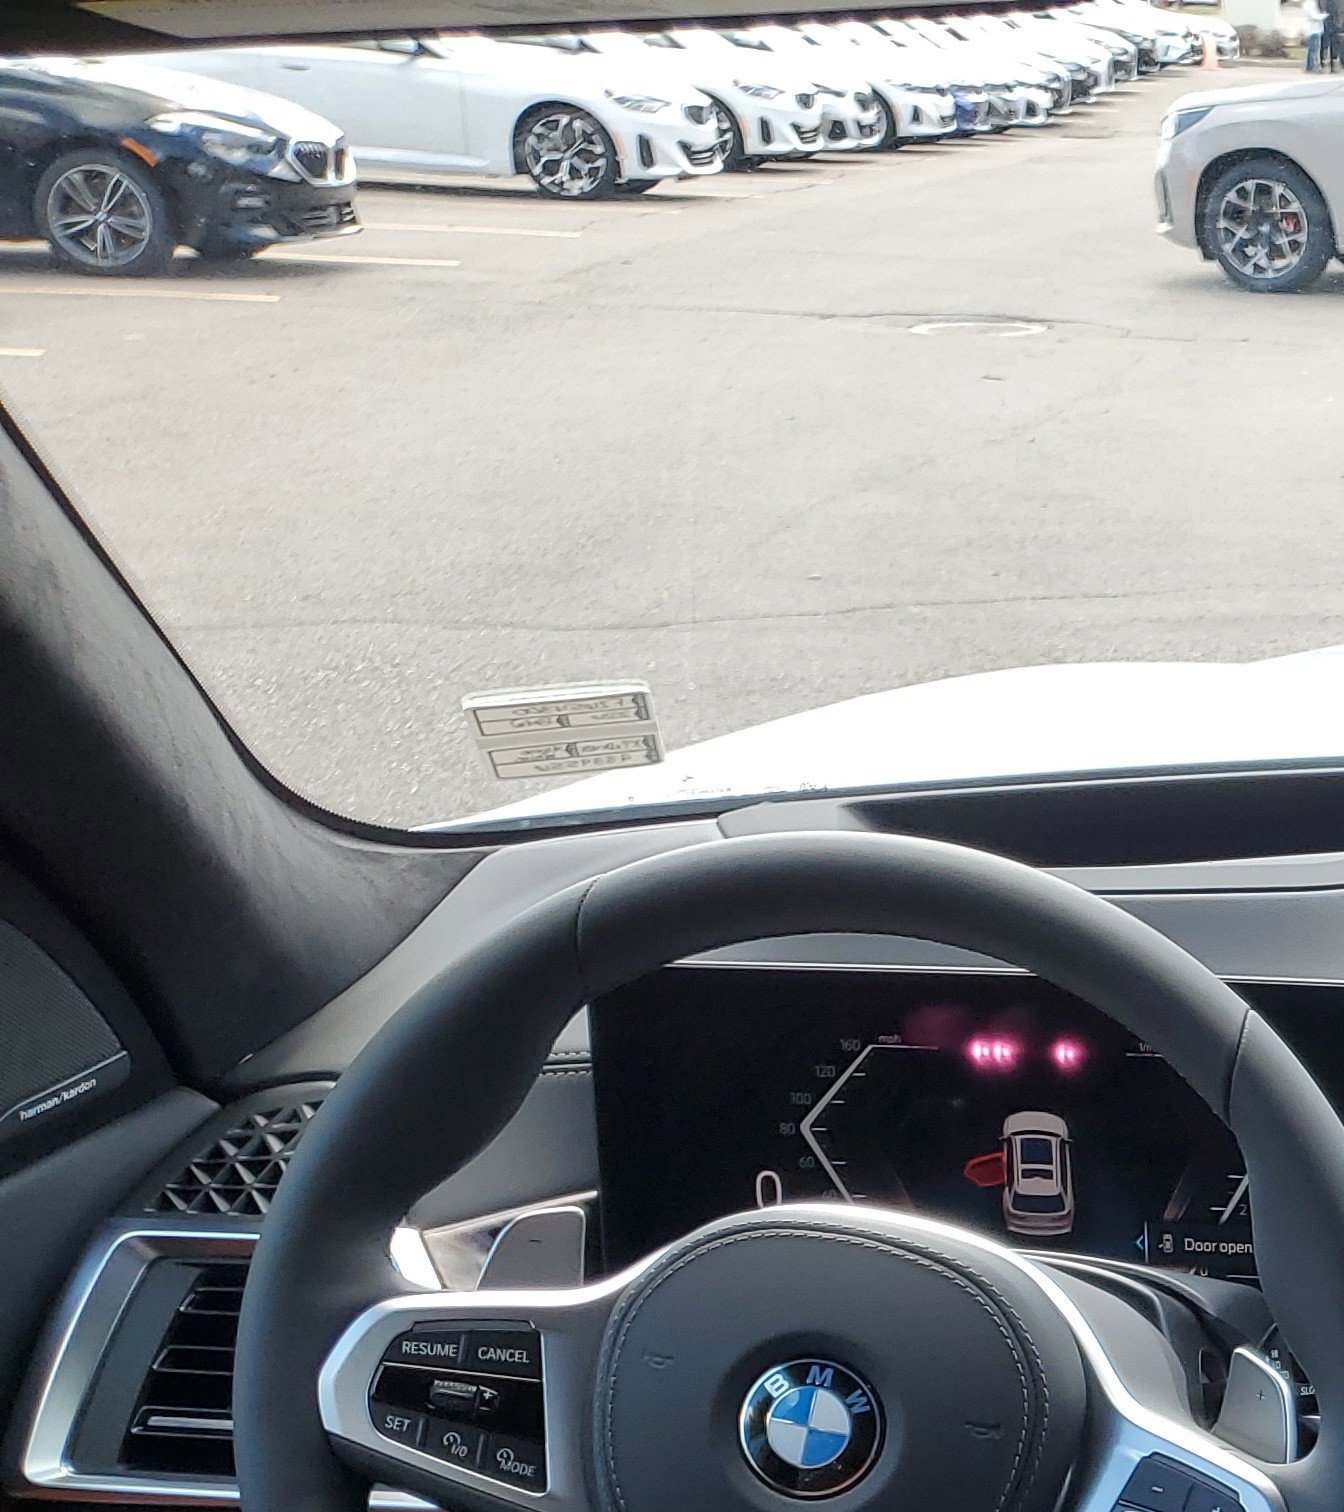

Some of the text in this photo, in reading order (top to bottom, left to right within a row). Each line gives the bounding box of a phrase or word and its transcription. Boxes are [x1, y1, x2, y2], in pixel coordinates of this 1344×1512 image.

[815, 1065, 836, 1078] 120
[19, 1077, 97, 1122] harman/kardon
[779, 1123, 796, 1135] 80
[1184, 1237, 1253, 1255] Door open
[401, 1340, 459, 1357] RESUME
[477, 1346, 530, 1364] CANCEL
[763, 1365, 871, 1414] BMW
[384, 1414, 412, 1432] SET
[499, 1459, 536, 1477] MODE
